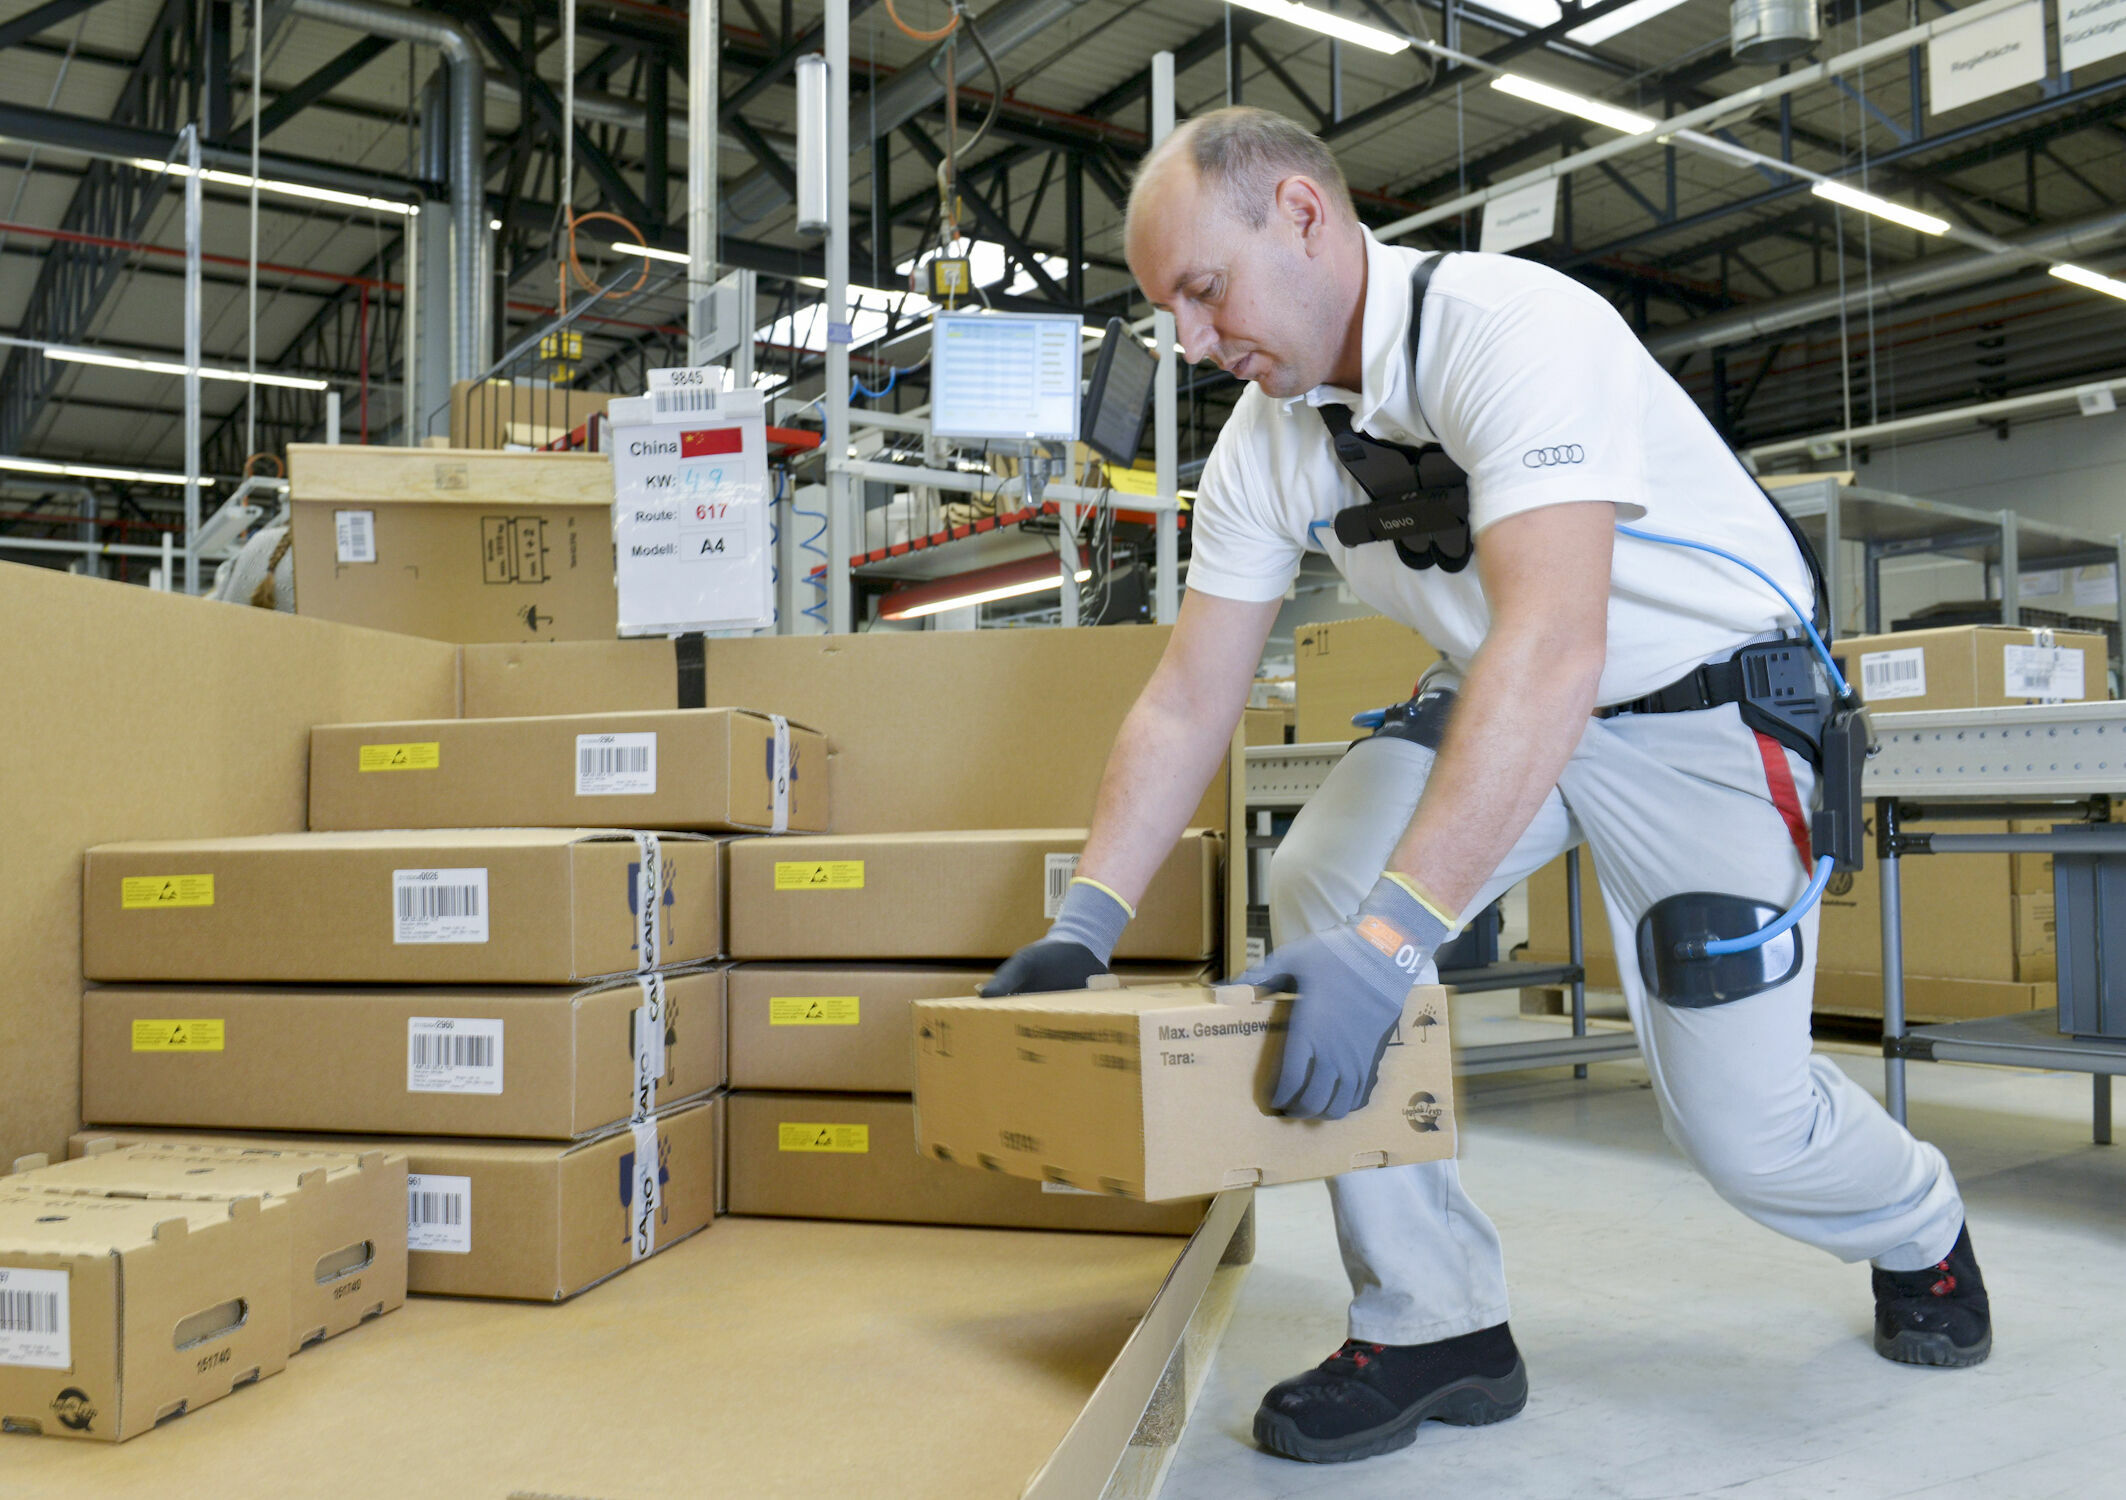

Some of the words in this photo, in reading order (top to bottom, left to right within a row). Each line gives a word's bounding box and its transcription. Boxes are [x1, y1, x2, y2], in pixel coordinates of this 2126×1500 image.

[671, 371, 704, 385] 9845
[630, 440, 677, 456] China
[646, 474, 677, 489] KW:
[685, 467, 723, 494] 49
[635, 508, 677, 522] Route:
[696, 503, 728, 520] 617
[1379, 516, 1415, 531] laevo
[632, 543, 677, 557] Modell:
[700, 537, 725, 554] A4
[1395, 944, 1421, 974] 10
[1158, 1025, 1190, 1041] Max.
[1193, 1017, 1271, 1038] Gesamtgew
[1160, 1052, 1195, 1066] Tara:
[197, 1347, 232, 1376] 151740
